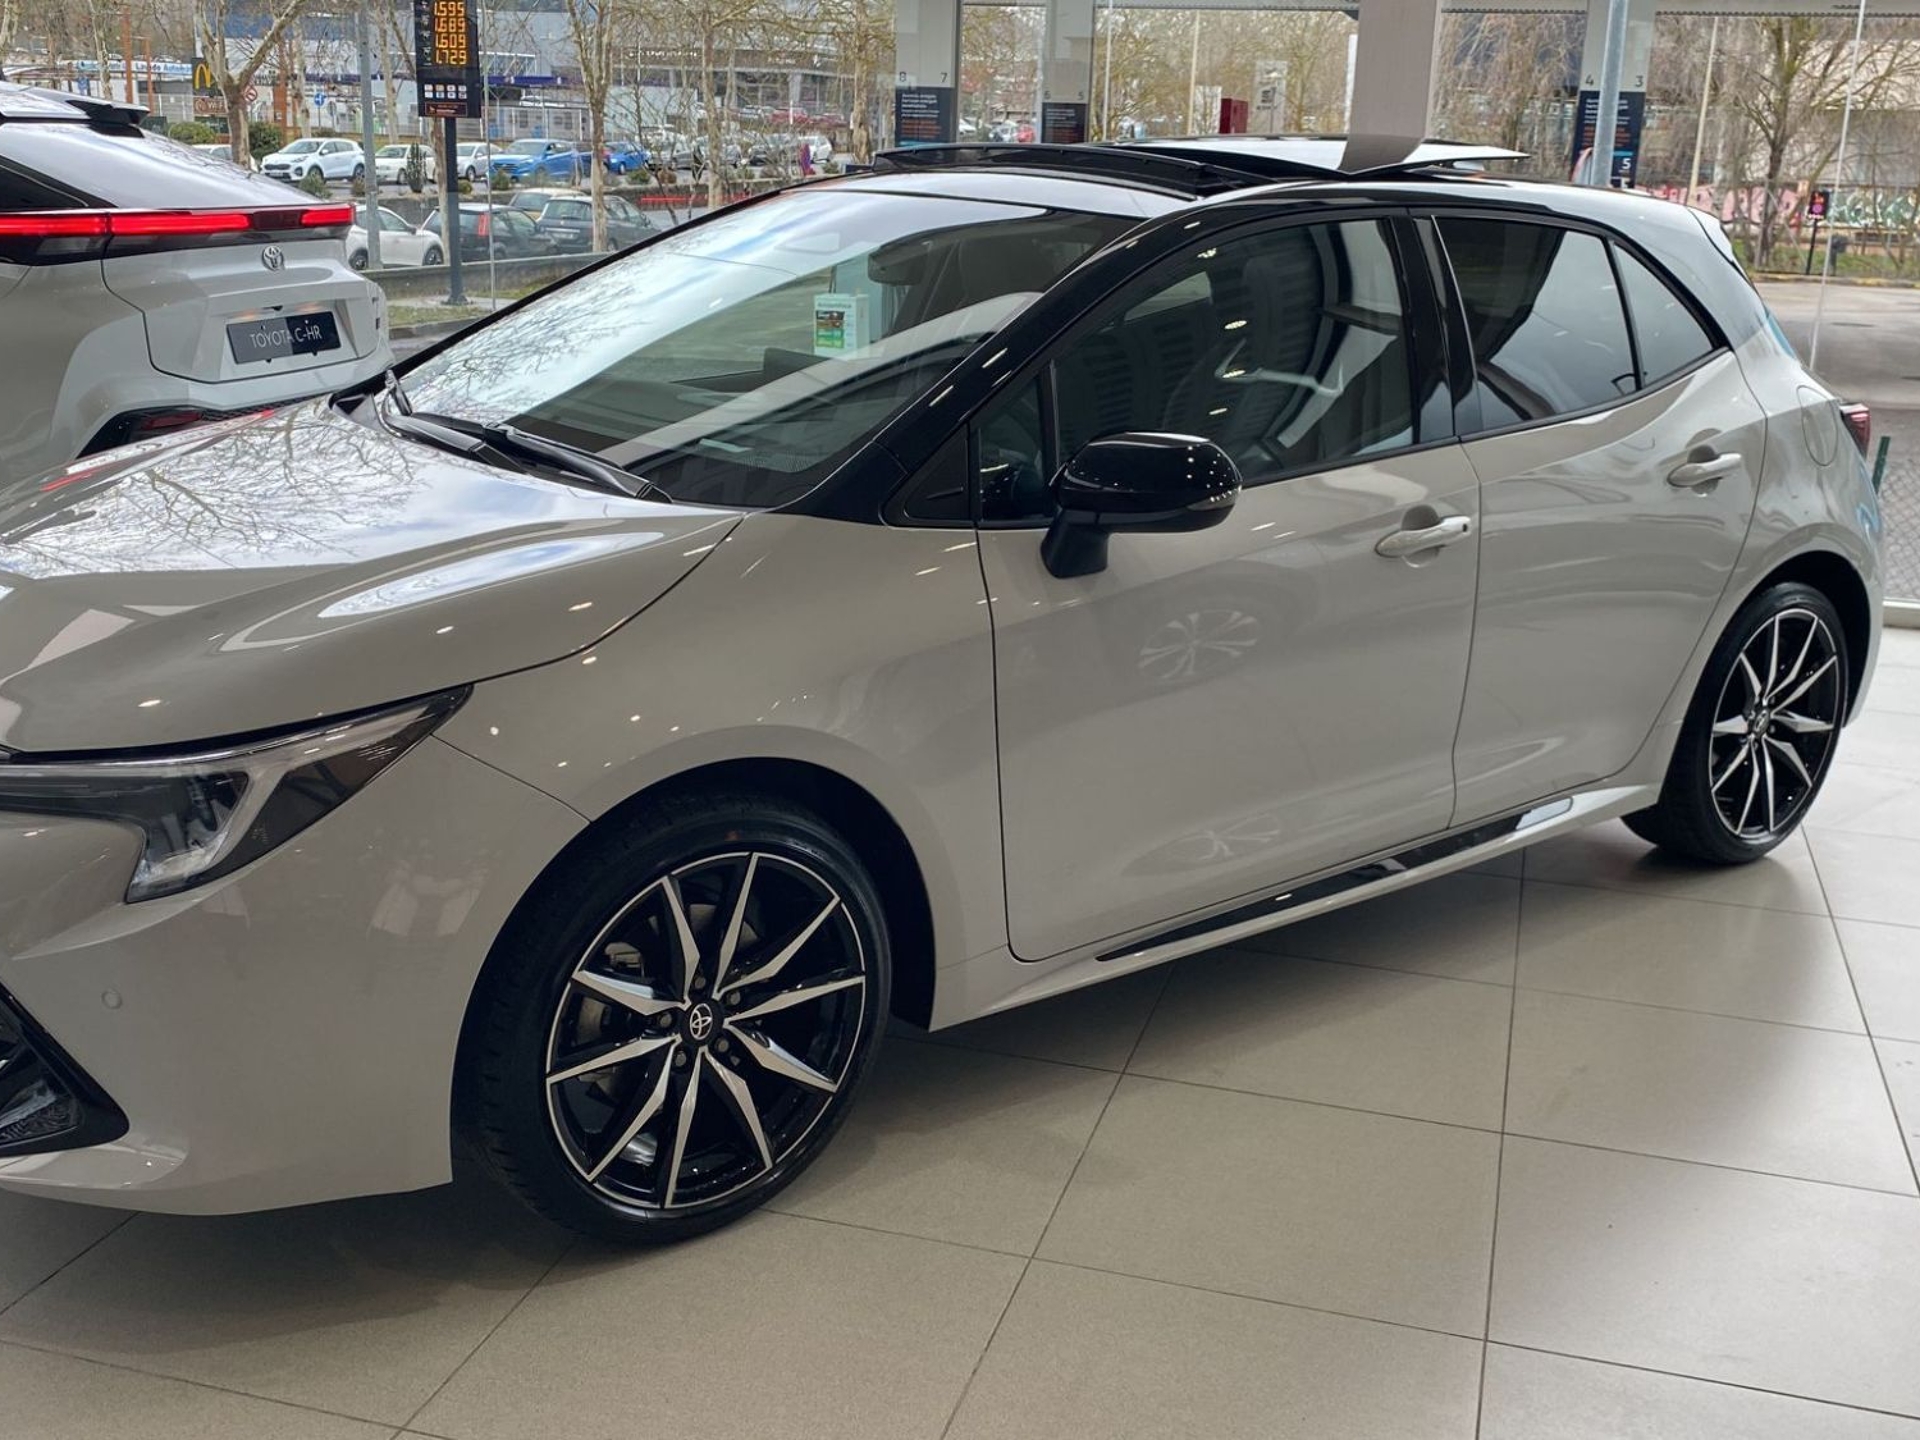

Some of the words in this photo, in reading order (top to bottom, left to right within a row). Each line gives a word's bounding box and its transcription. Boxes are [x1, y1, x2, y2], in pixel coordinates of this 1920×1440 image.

[899, 71, 907, 82] 8
[940, 72, 948, 83] 7
[1585, 74, 1594, 86] 4
[1635, 75, 1643, 87] 3
[250, 329, 295, 348] TOYOTA
[294, 325, 322, 342] C-HR
